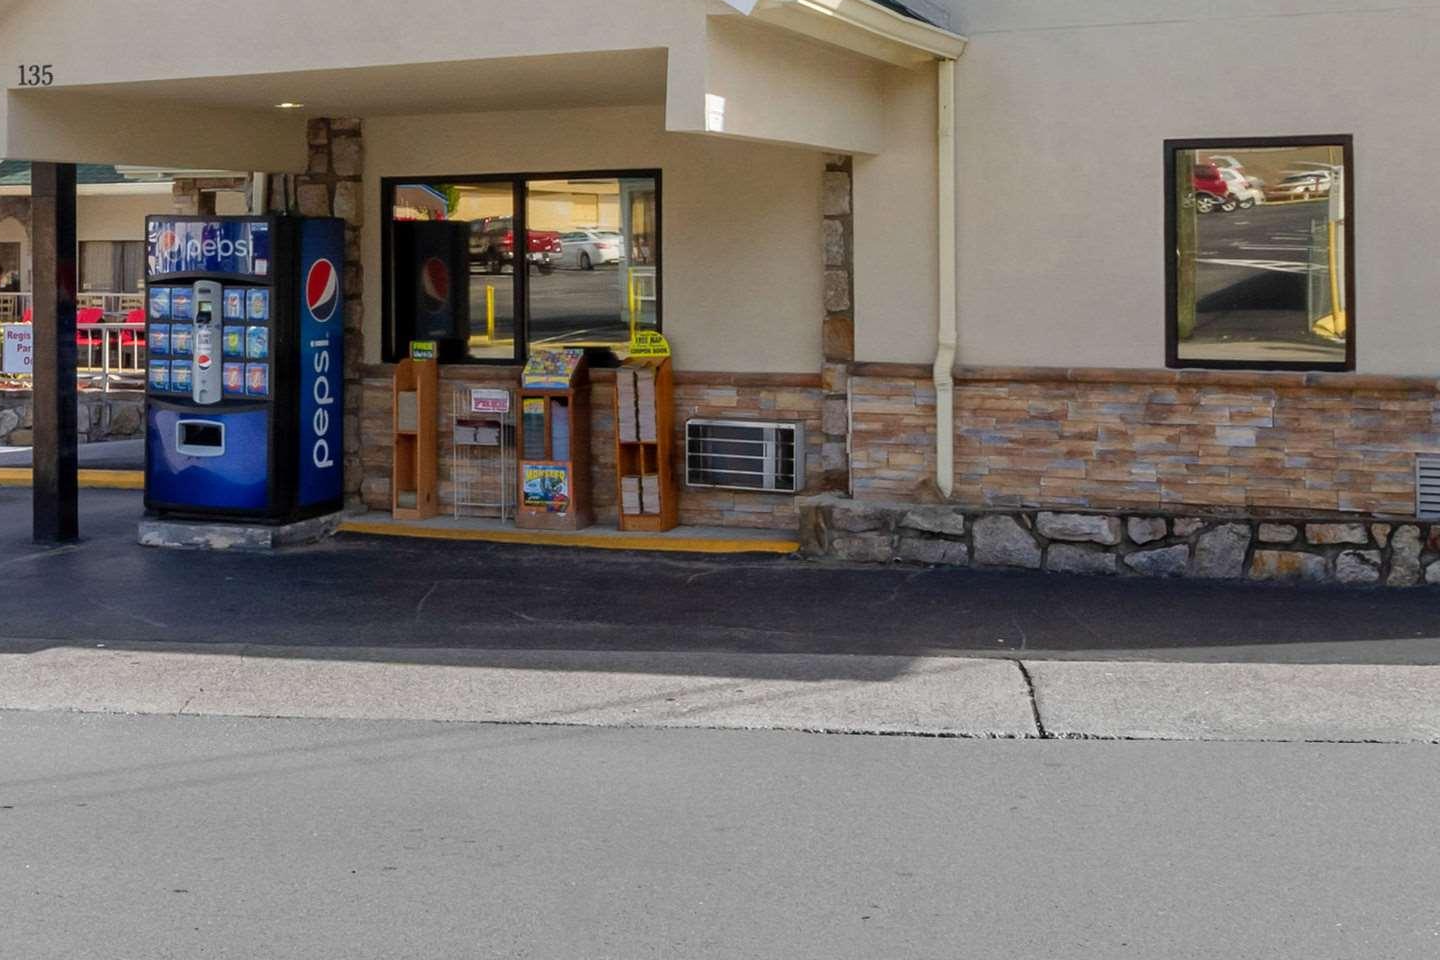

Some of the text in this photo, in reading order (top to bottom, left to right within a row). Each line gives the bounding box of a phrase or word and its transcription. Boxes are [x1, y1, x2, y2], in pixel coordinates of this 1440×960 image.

[18, 64, 54, 86] 135
[186, 233, 253, 262] pepsi
[7, 330, 32, 342] Regis
[16, 343, 32, 353] Par
[310, 339, 334, 468] pepsi
